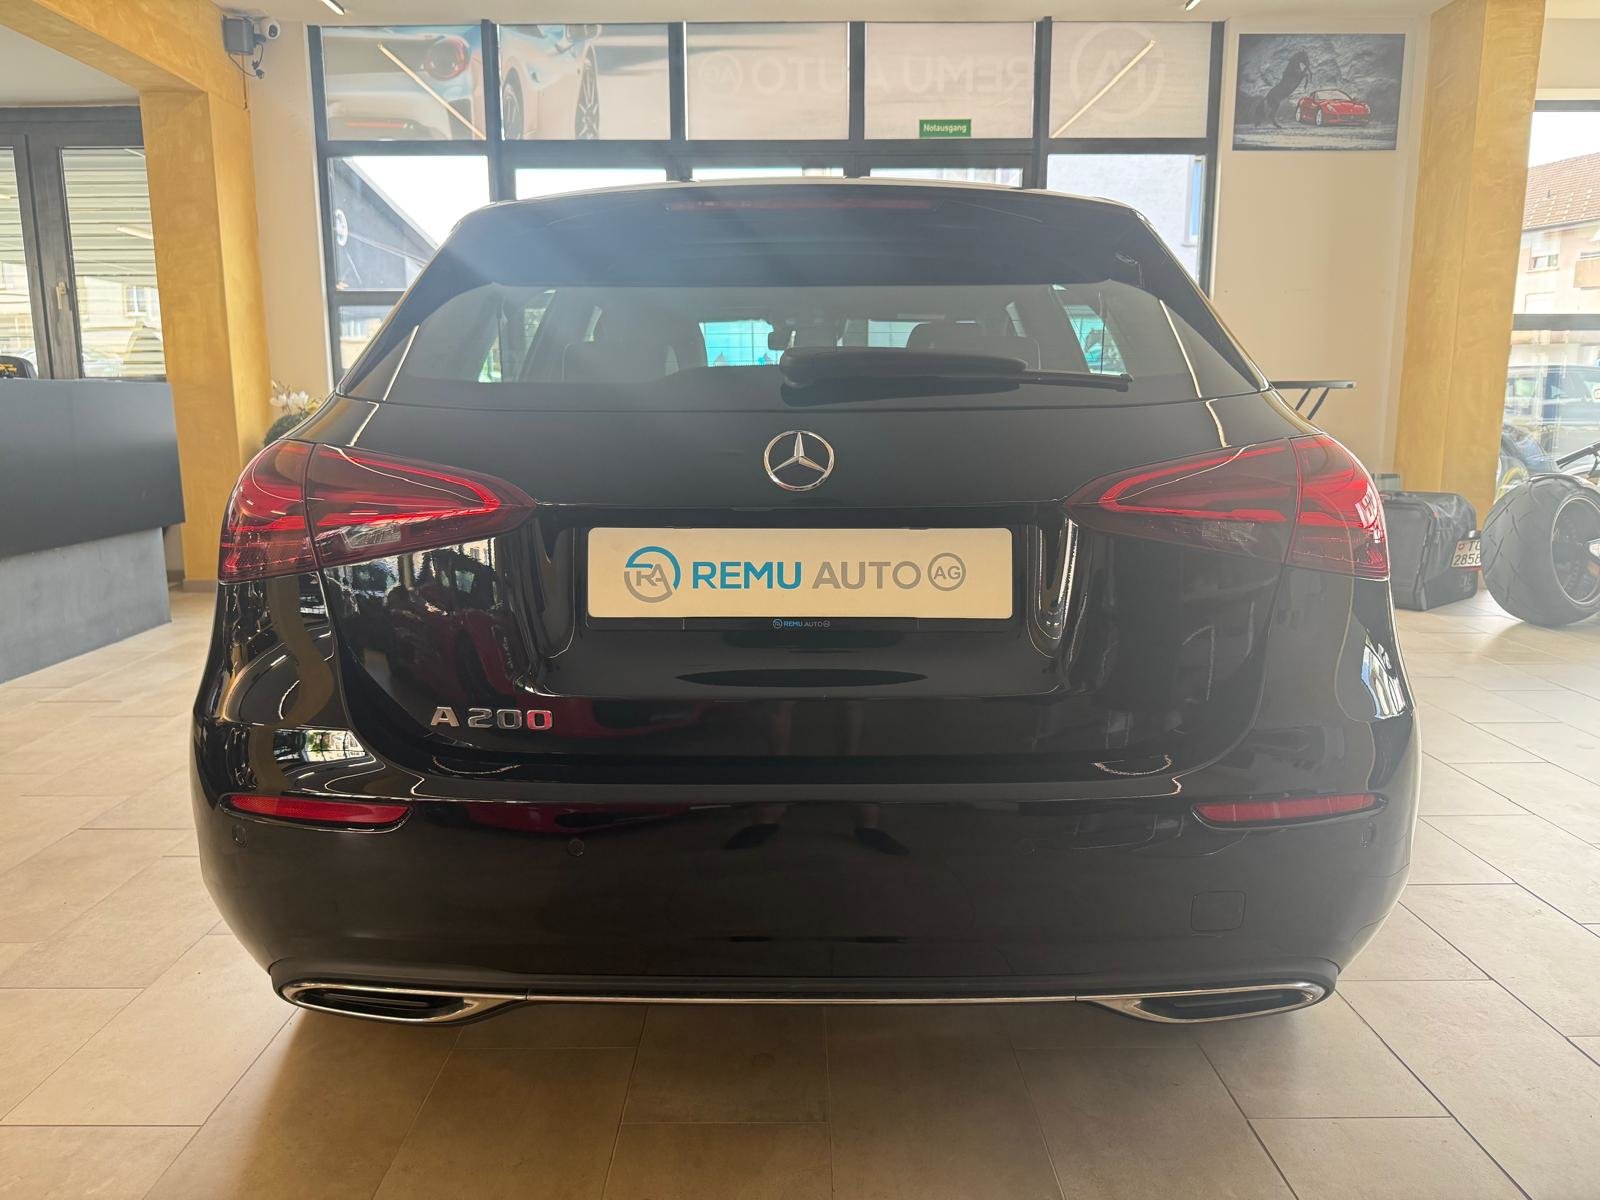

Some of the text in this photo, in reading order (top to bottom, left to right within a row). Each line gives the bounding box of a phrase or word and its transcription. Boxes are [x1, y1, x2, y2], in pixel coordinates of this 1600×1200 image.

[923, 123, 967, 133] Notausgang
[692, 561, 801, 590] REMU
[812, 561, 922, 590] AUTO
[933, 566, 962, 581] AG
[430, 706, 553, 730] A 200
